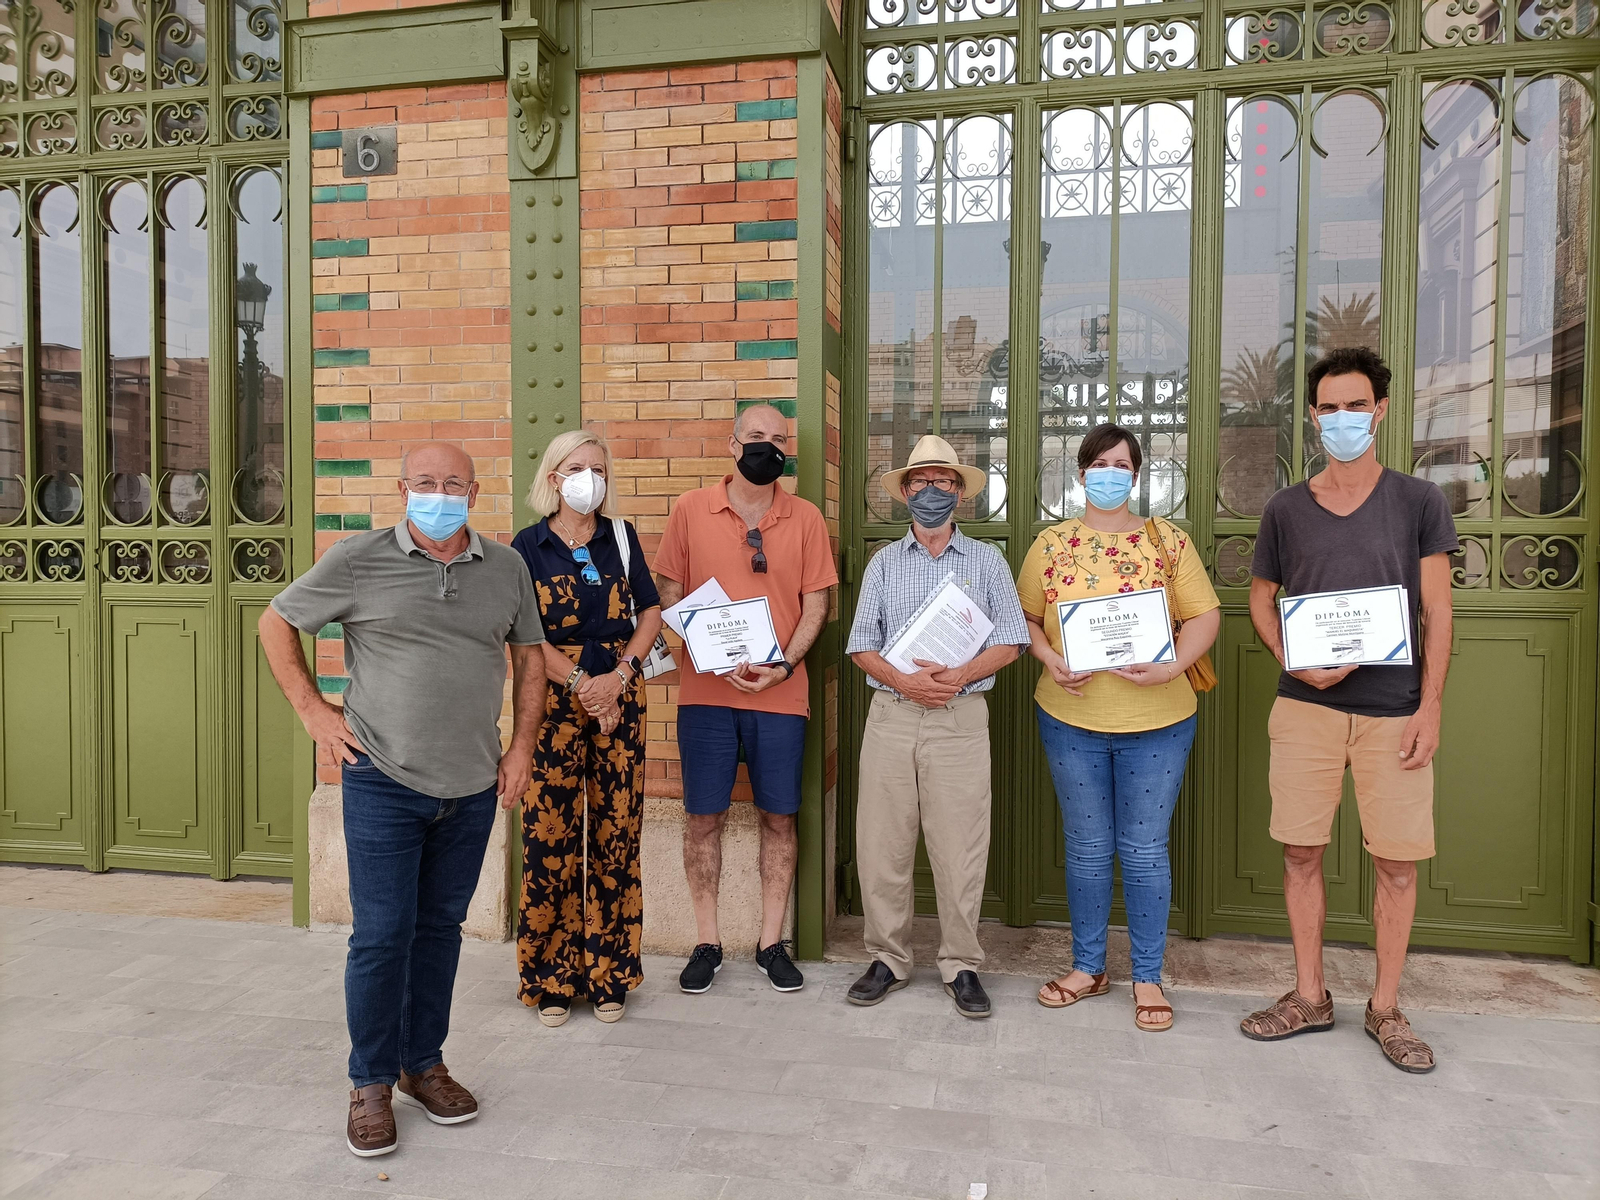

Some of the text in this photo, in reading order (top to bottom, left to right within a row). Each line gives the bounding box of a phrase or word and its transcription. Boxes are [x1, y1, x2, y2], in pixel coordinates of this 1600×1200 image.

[357, 133, 380, 171] 6
[1089, 612, 1139, 625] DIPLOMA
[1315, 609, 1370, 620] DIPLOMA
[706, 619, 748, 630] DIPLOMA
